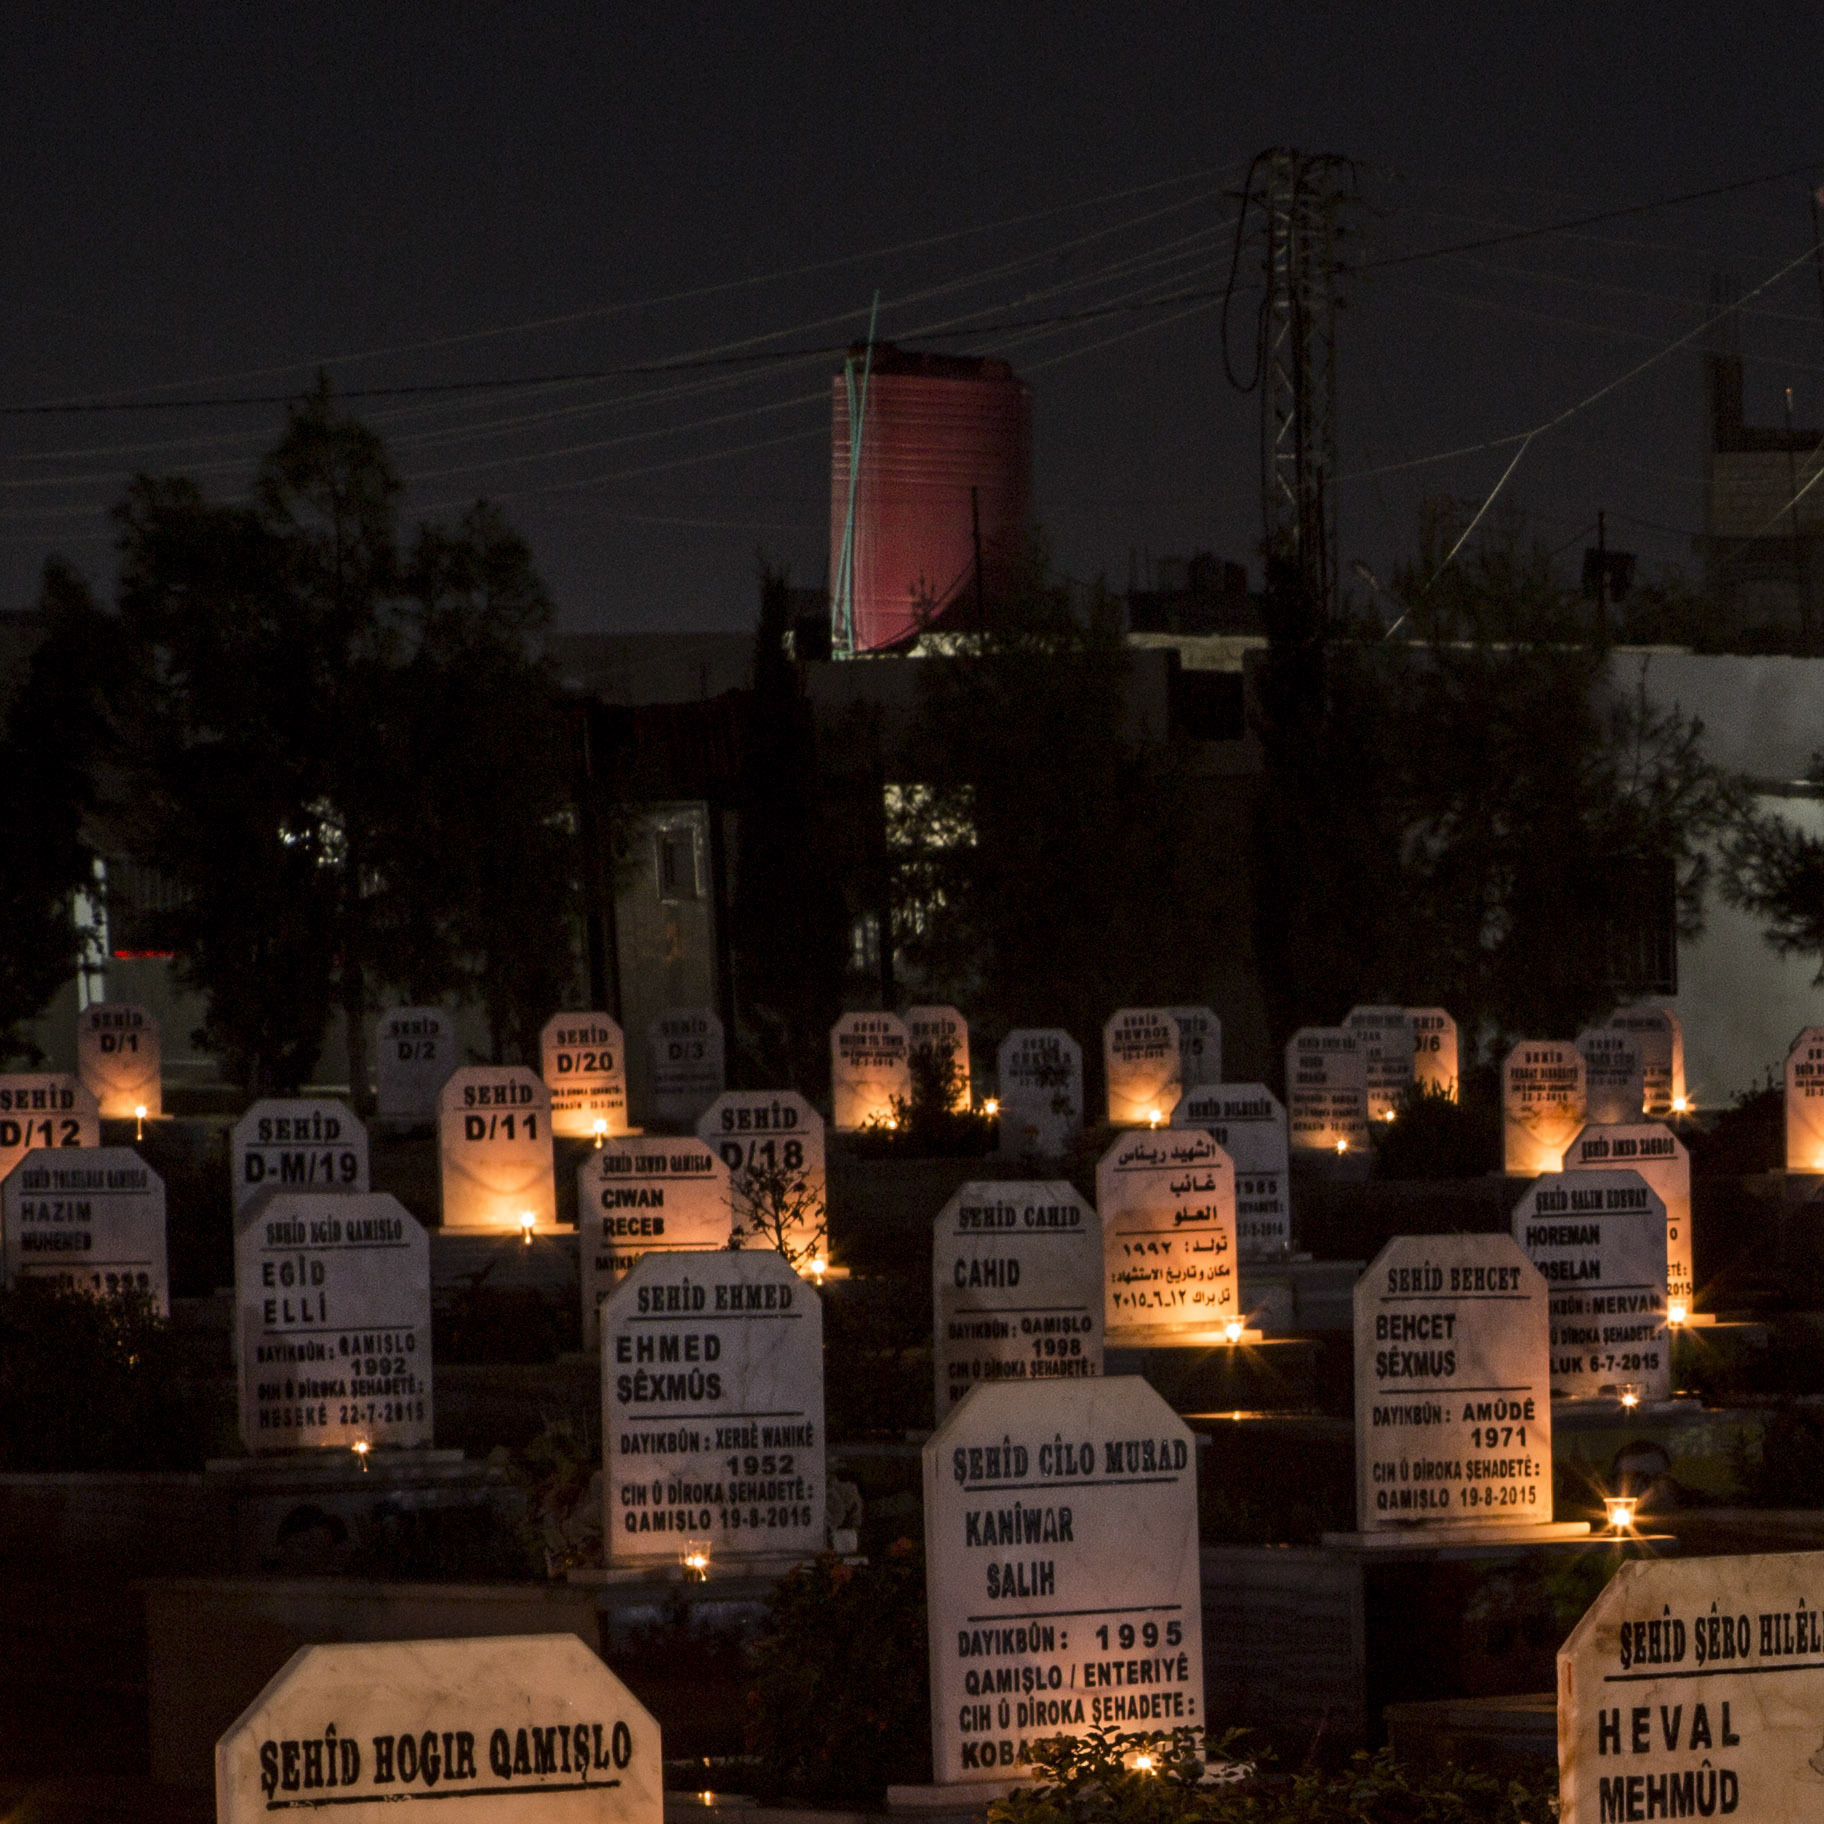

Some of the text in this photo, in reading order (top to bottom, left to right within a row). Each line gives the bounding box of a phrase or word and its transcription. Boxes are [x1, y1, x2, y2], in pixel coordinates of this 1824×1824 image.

[557, 1053, 613, 1073] D/20
[0, 1120, 81, 1147] D/12
[465, 1115, 538, 1141] D/11
[245, 1152, 357, 1183] D-M/19
[720, 1139, 802, 1171] D/18
[954, 1258, 1020, 1287] CAHID
[715, 1285, 793, 1309] EHMED
[1376, 1314, 1456, 1340] BEHCET
[616, 1334, 720, 1363] EHMED
[1471, 1427, 1527, 1448] 1971
[727, 1457, 794, 1476] 1952
[954, 1434, 1187, 1485] ŞEHÎD CÎLO MURAD
[966, 1502, 1073, 1547] KANÎWAR
[987, 1562, 1055, 1599] SALIH
[1096, 1622, 1182, 1650] 1995
[1621, 1605, 1686, 1671] ŞEHÎD
[1696, 1601, 1750, 1667] ŞÊRO
[965, 1652, 1189, 1696] QAMIŞLO ENTERIYÊ
[1599, 1701, 1740, 1755] HEVAL
[261, 1722, 631, 1799] ŞEHÎD HOGIR QAMIŞLO
[1601, 1760, 1739, 1824] MEHMÛD
